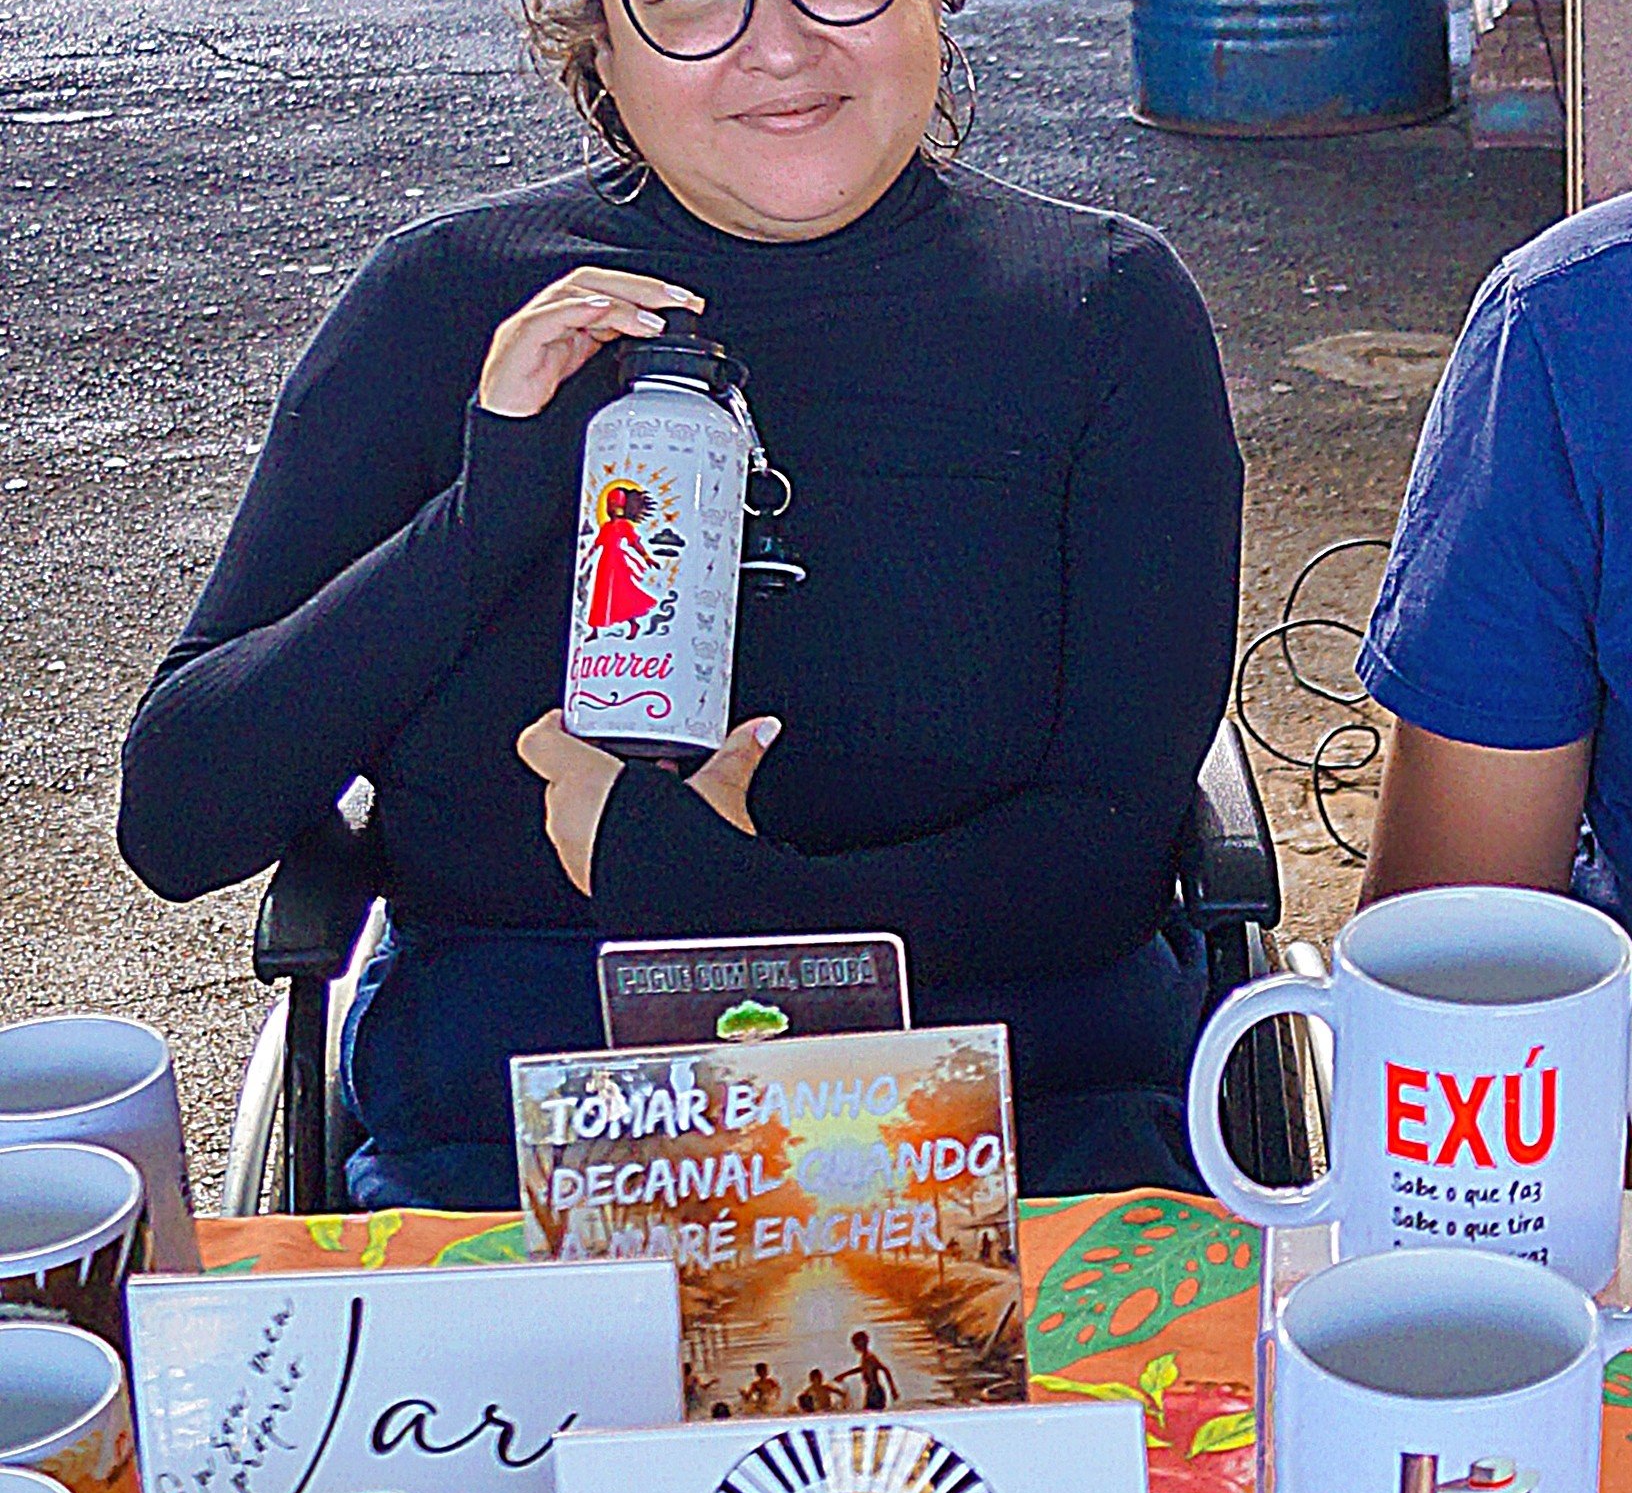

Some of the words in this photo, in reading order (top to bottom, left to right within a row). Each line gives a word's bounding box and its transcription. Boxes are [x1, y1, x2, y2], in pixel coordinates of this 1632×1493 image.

[541, 1086, 713, 1140] TOMAR
[724, 1074, 899, 1130] BANHO
[1384, 1044, 1558, 1169] EXÚ
[796, 1134, 1001, 1197] QUANDO
[1391, 1171, 1440, 1200] Sabe
[1446, 1187, 1457, 1202] o
[1464, 1188, 1501, 1208] que
[1508, 1180, 1543, 1205] faz
[610, 1208, 738, 1269] MARÉ
[753, 1206, 945, 1261] ENCHER
[1391, 1206, 1440, 1235] Sabe
[1446, 1221, 1457, 1236] o
[1464, 1222, 1501, 1243] que
[1507, 1213, 1546, 1235] tira
